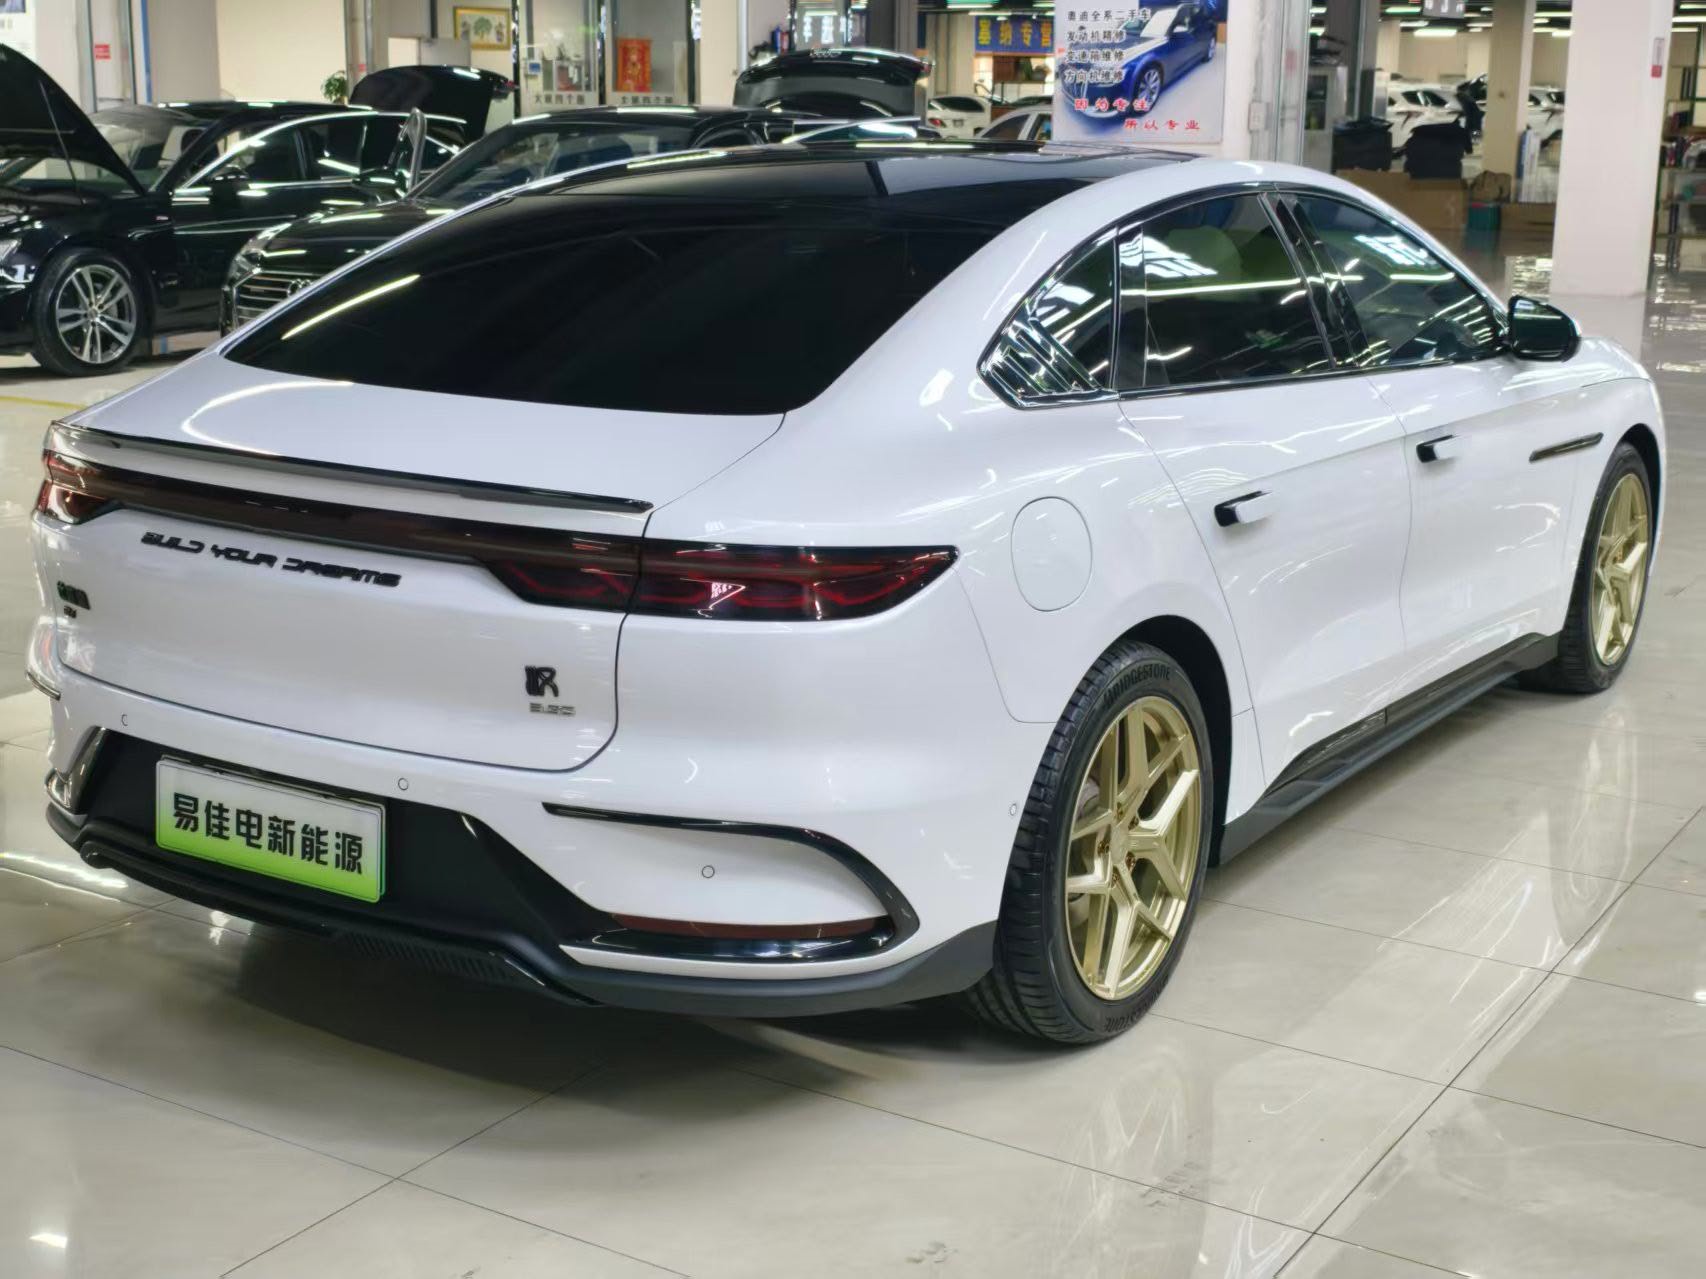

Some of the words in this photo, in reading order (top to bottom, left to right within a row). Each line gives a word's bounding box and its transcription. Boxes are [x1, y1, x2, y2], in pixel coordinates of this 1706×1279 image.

[1124, 118, 1200, 130] 所以专业
[141, 531, 205, 554] BUILD
[211, 544, 278, 569] YOUR
[282, 558, 402, 588] DREAMS
[173, 792, 363, 875] 易佳电新能源
